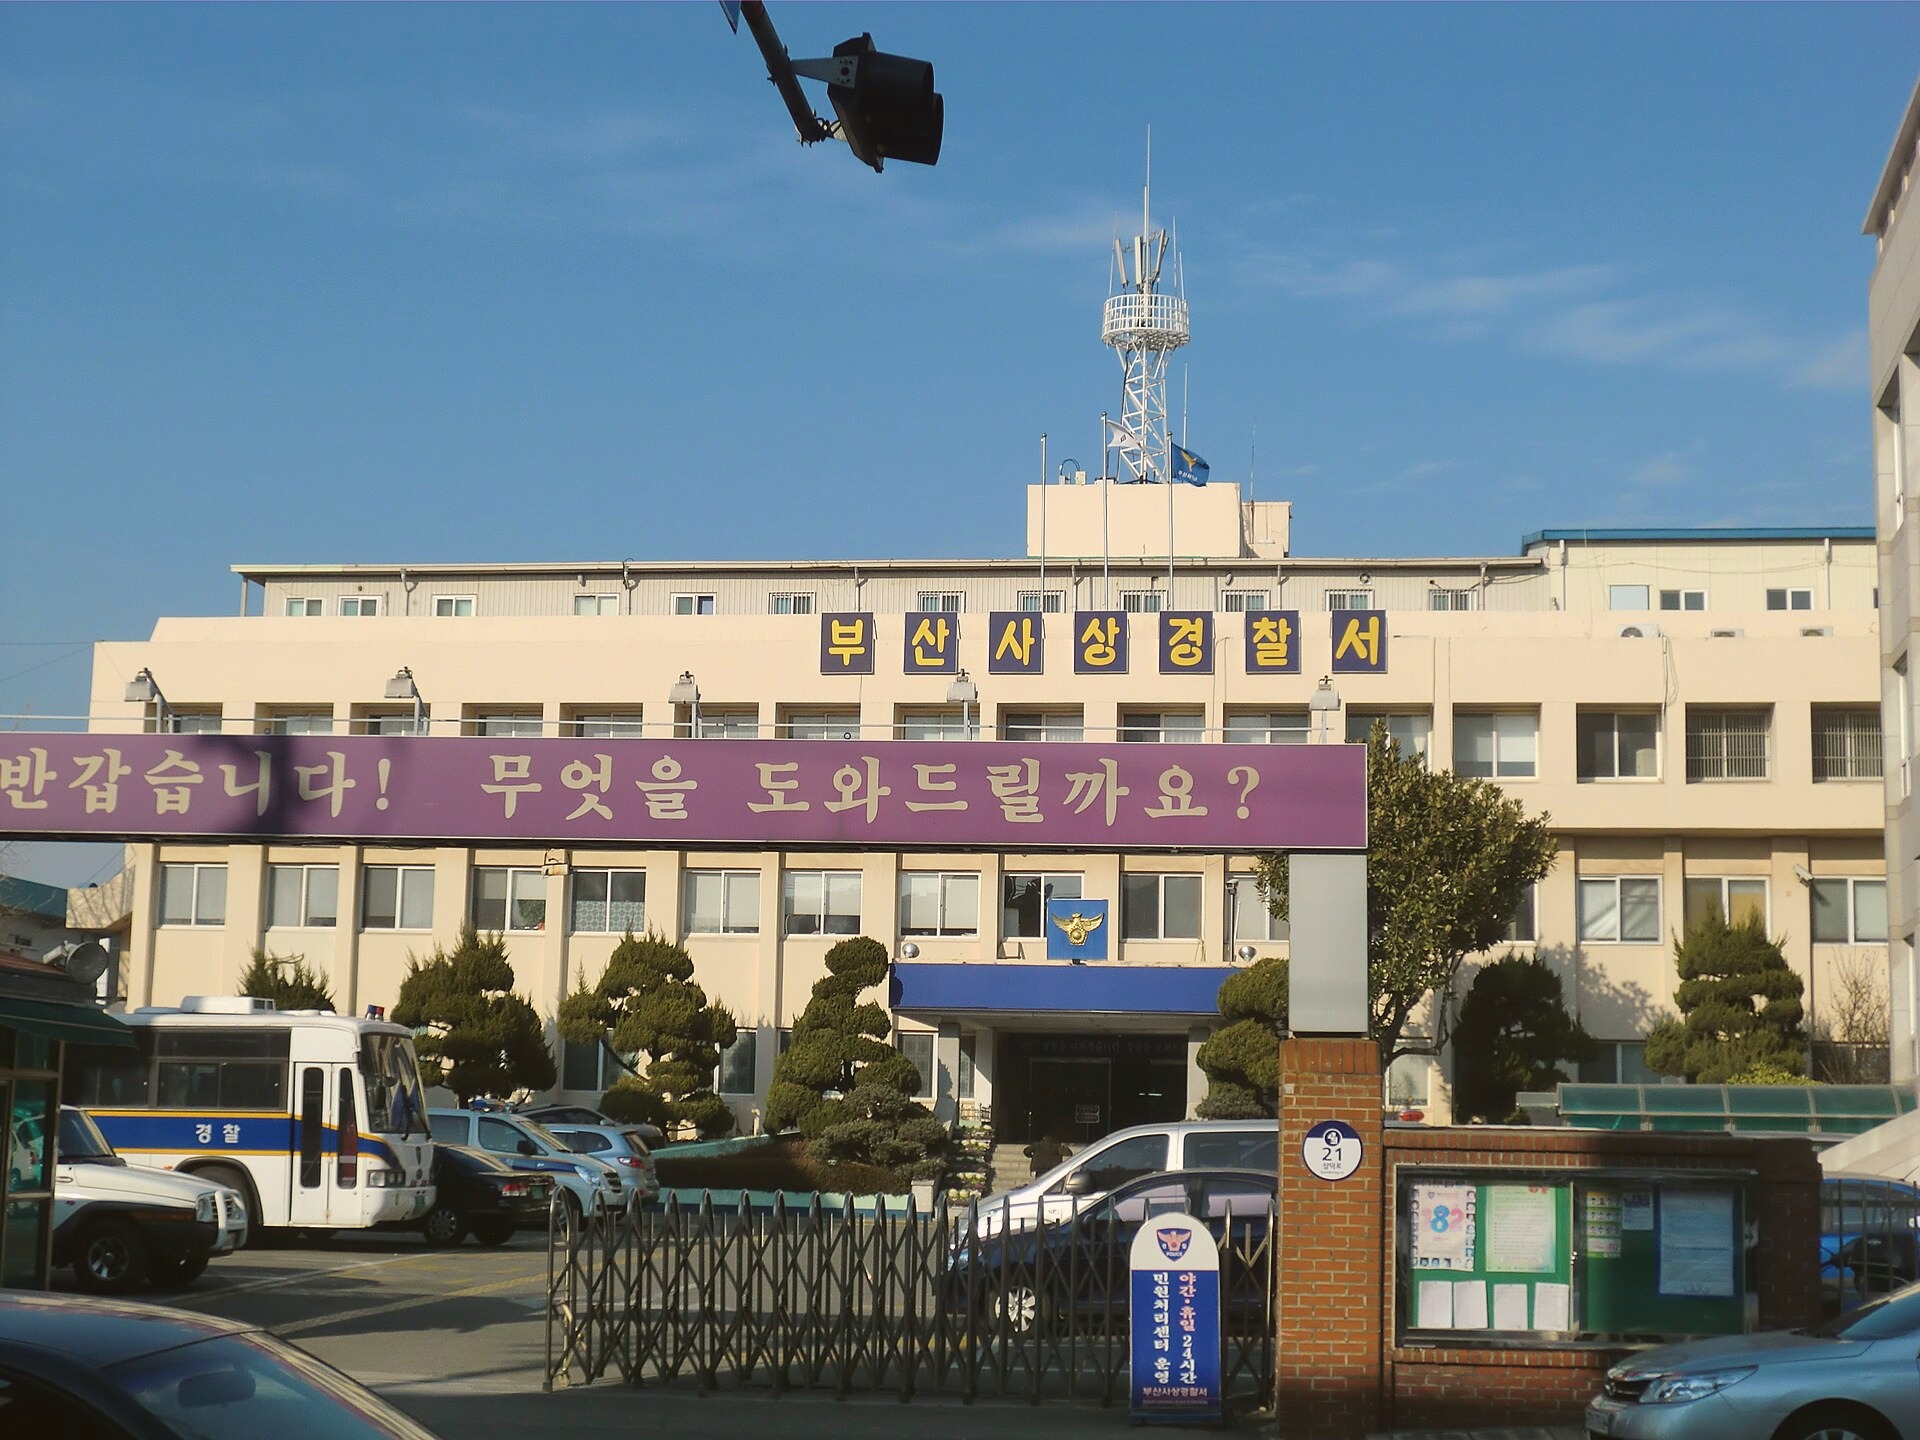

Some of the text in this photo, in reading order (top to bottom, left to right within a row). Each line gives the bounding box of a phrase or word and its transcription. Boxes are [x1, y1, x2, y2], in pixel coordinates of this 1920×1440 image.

[828, 617, 1380, 667] 부산사상경찰서
[0, 748, 1261, 827] 반갑습니다! 무엇을 도와드릴까요?
[196, 1124, 240, 1144] 경찰
[1322, 1147, 1342, 1161] 21
[1153, 1272, 1171, 1385] 민원처리센터 운영
[1179, 1335, 1197, 1385] 24시간
